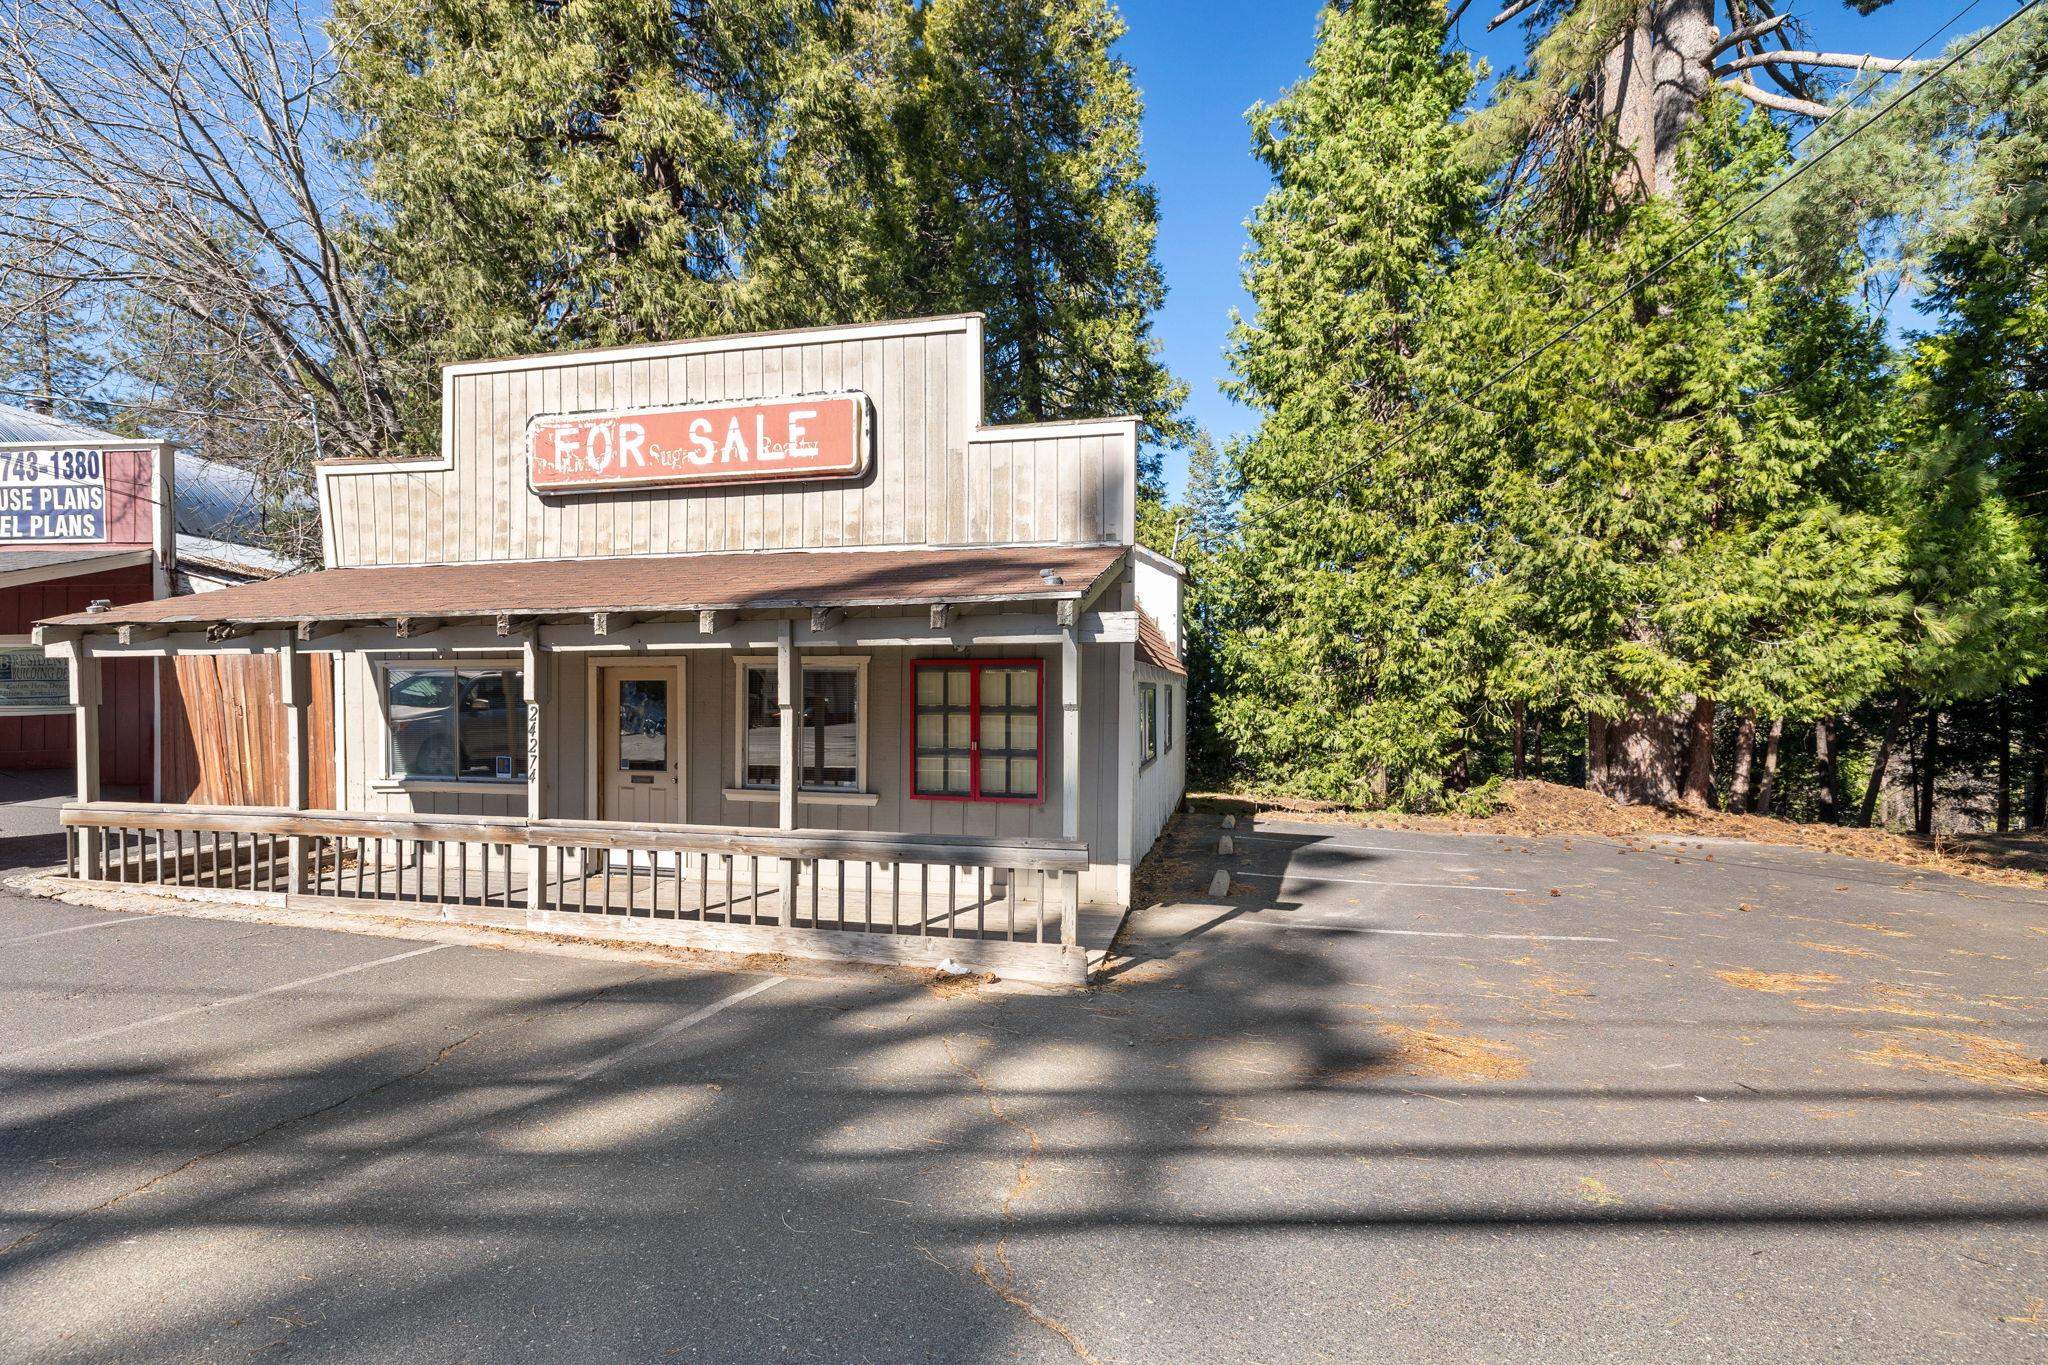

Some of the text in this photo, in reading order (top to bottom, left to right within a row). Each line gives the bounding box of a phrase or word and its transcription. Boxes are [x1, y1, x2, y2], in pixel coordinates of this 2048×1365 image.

[554, 410, 819, 473] FOR SALE
[40, 486, 103, 510] PLANS
[30, 513, 95, 537] PLANS
[527, 706, 539, 784] 24274
